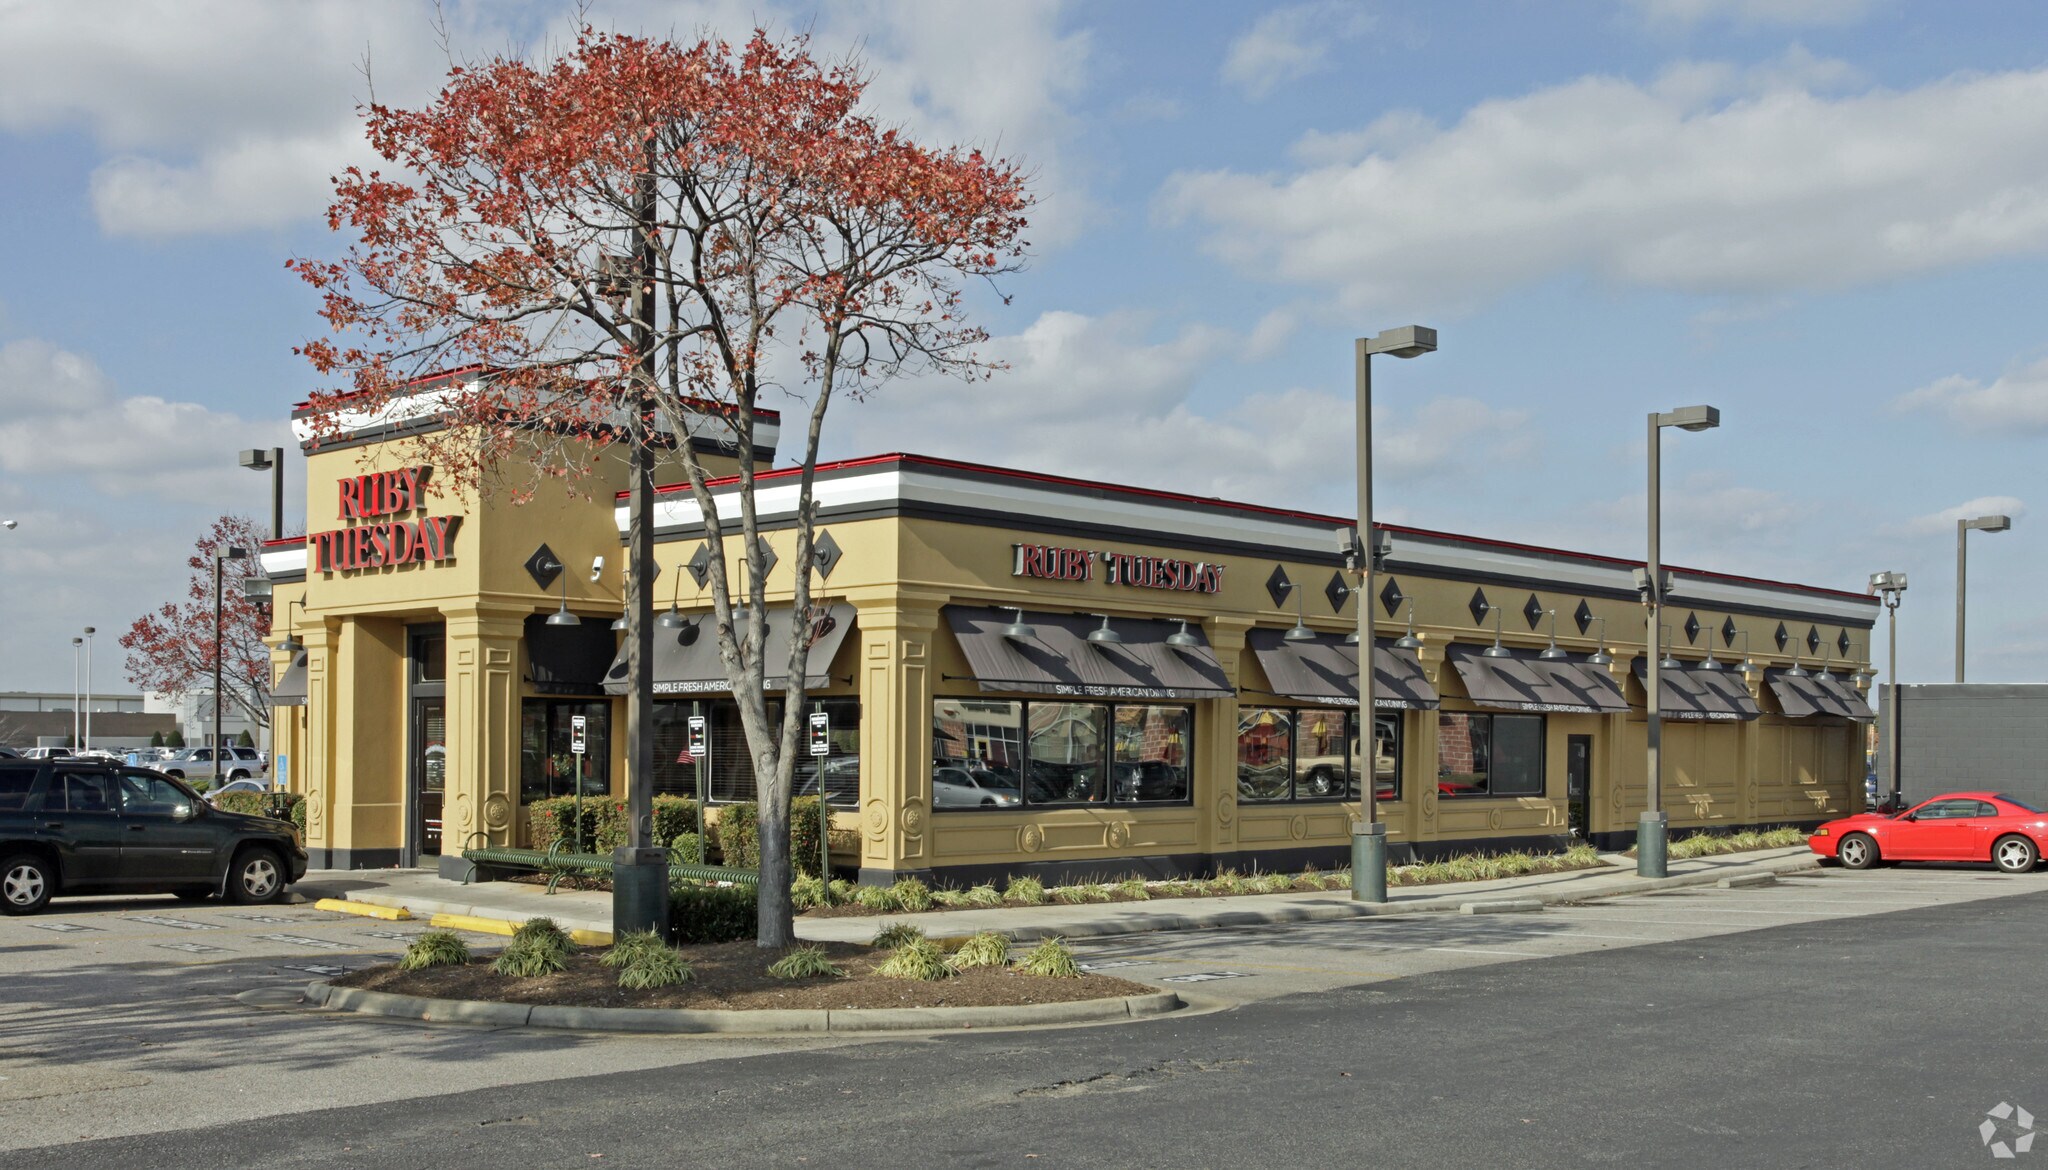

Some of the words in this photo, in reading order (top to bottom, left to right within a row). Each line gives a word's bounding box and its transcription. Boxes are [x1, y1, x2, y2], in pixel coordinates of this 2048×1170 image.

[337, 465, 429, 521] RUBY
[309, 516, 459, 574] TUESDAY
[1016, 543, 1099, 581] RUBY
[1104, 552, 1227, 594] TUESDAY
[653, 682, 678, 693] SIMPLE
[678, 681, 703, 693] FRESH
[703, 680, 732, 692] AMERIC
[1055, 684, 1083, 695] SIMPLE
[1085, 685, 1109, 696] FRESH
[1110, 687, 1149, 697] AMERICAN
[1149, 688, 1176, 698] DINING
